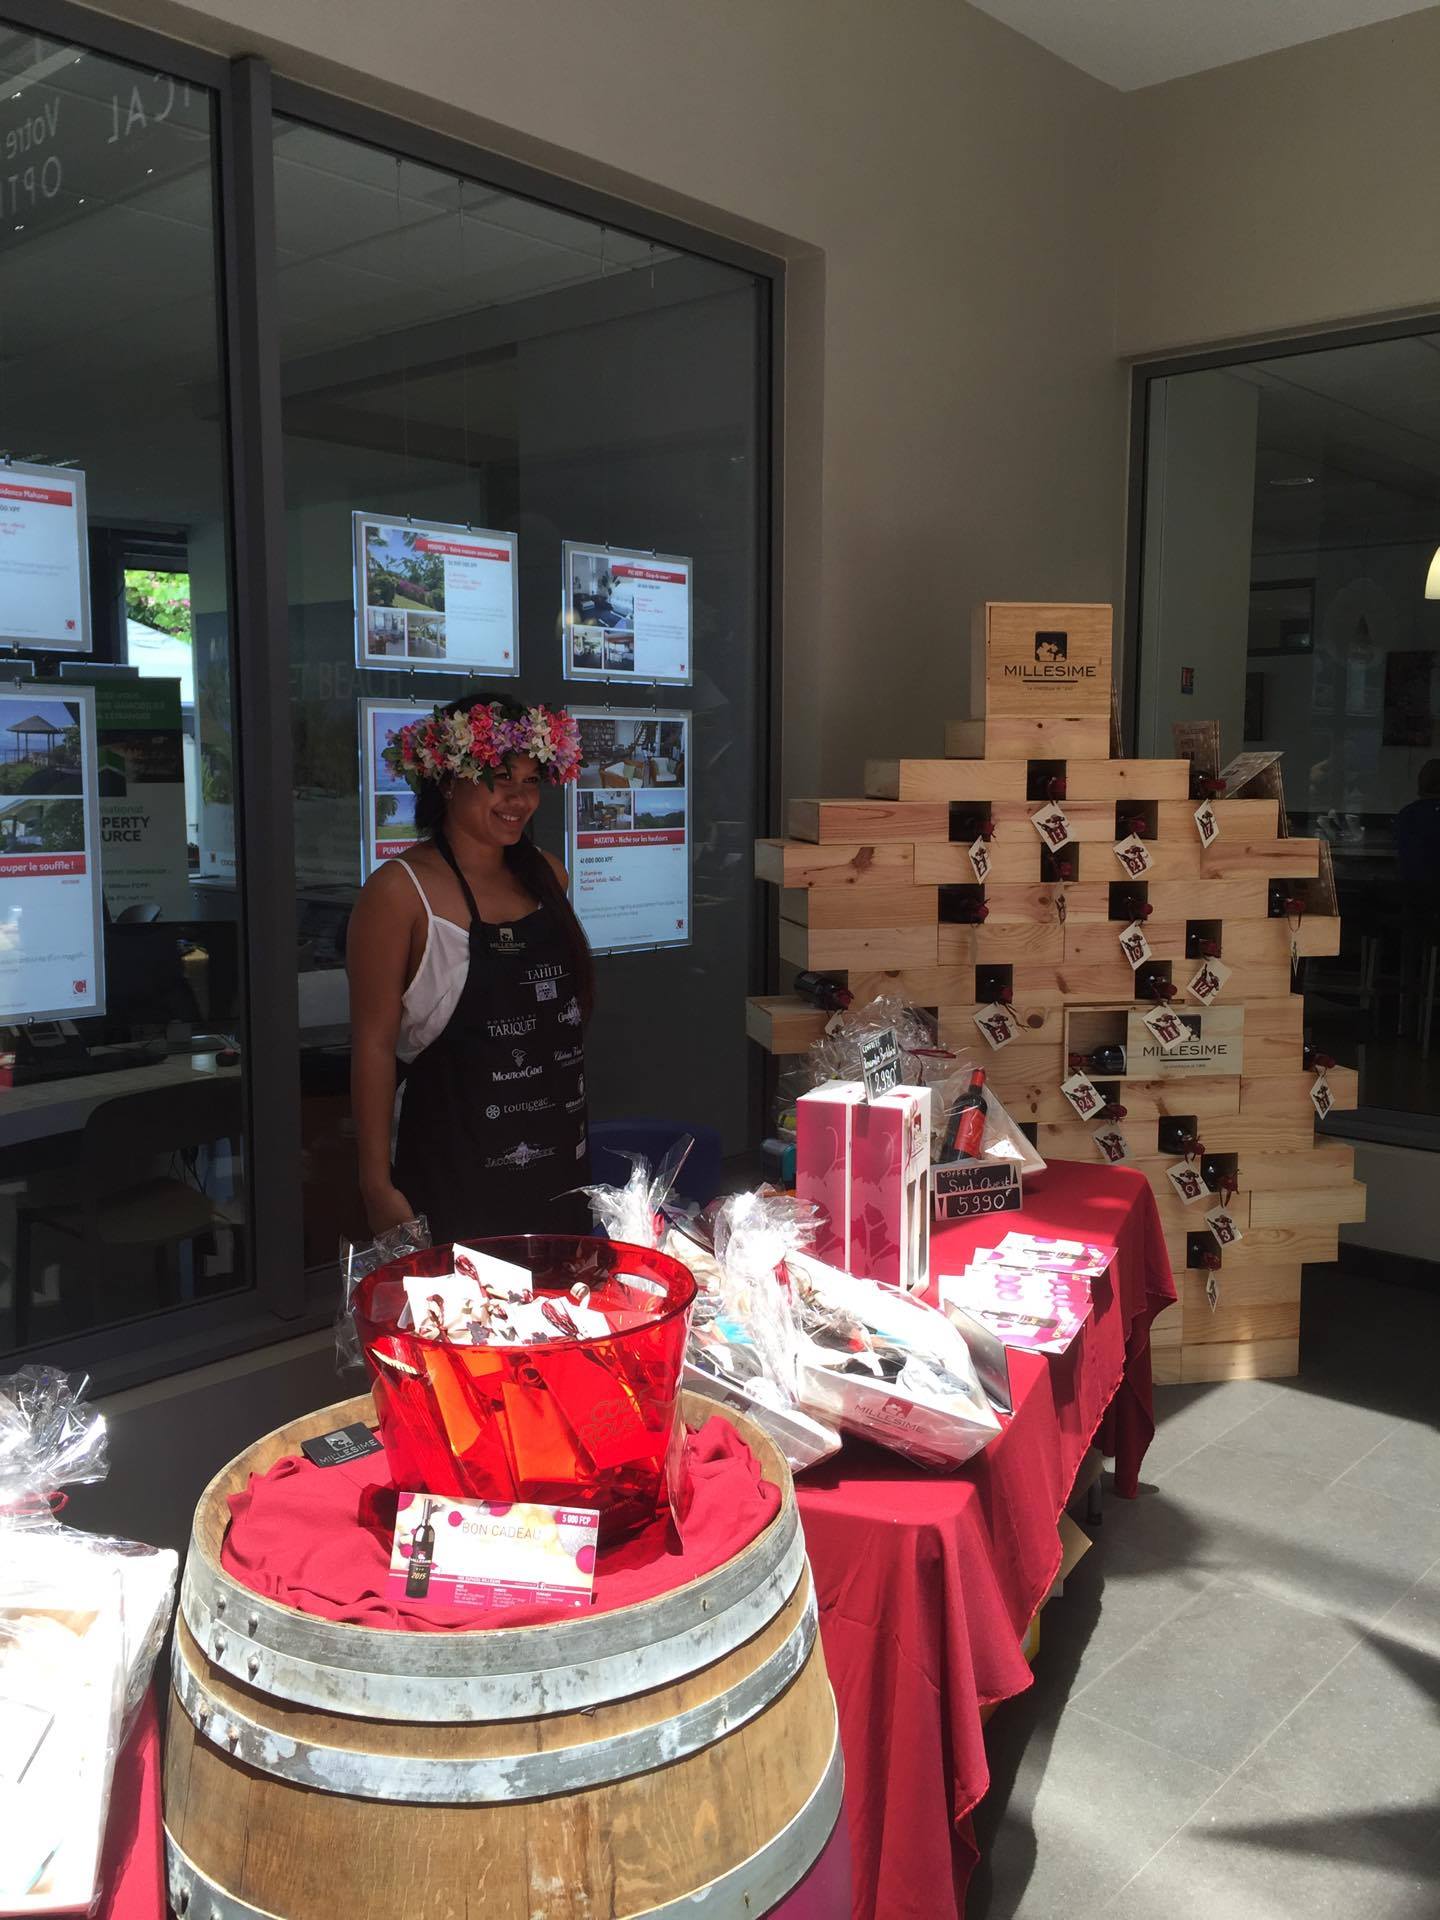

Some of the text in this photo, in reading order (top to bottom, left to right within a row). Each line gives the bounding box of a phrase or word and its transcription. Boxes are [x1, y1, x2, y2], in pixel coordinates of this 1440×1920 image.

[1004, 665, 1097, 677] MILLESIME
[101, 816, 151, 829] PERTY
[29, 861, 38, 872] le
[487, 1018, 537, 1037] TARIQUET
[996, 1028, 1005, 1042] 5
[1142, 1044, 1228, 1057] MILLESIME
[854, 1404, 924, 1433] MILLESIME
[318, 1438, 378, 1464] MILLESIME
[579, 1515, 592, 1525] FCP
[462, 1521, 488, 1536] BON
[411, 1571, 427, 1580] 2015
